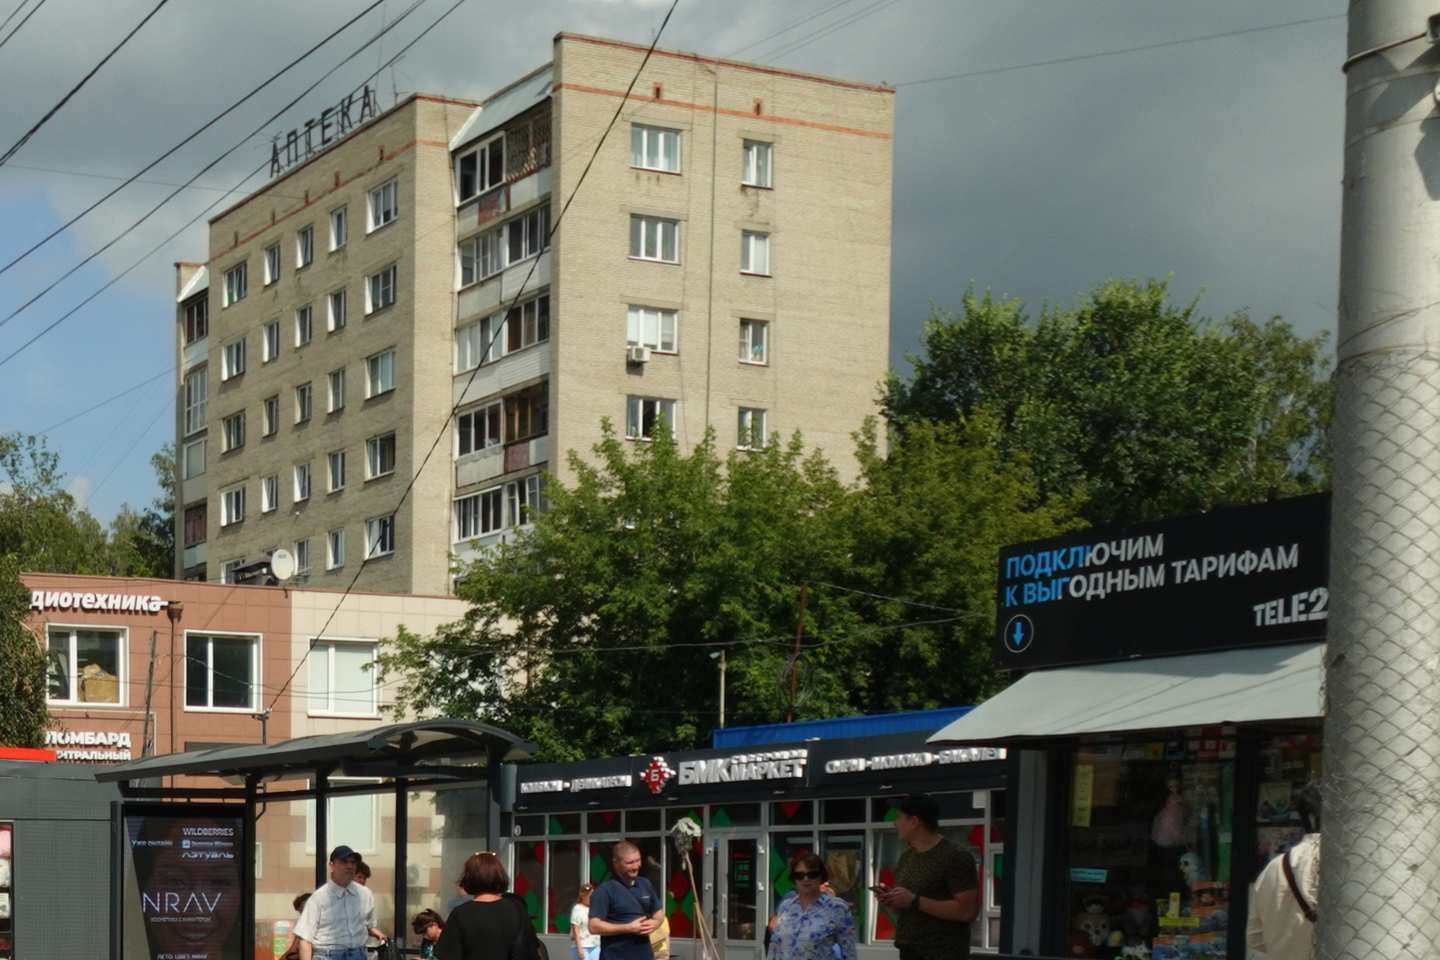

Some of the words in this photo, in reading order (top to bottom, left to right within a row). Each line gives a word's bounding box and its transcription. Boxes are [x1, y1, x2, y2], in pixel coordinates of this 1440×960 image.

[269, 85, 374, 178] АПТЕКА
[1005, 533, 1164, 579] ПОДКЛЮЧИМ
[1005, 585, 1018, 607] К
[1023, 563, 1165, 606] ВЫГОДНЫМ
[1171, 543, 1299, 584] ТАРИФАМ
[29, 590, 162, 613] диотехника
[1252, 587, 1329, 626] TELE2
[45, 730, 131, 748] ЛОМБАРД
[57, 749, 131, 760] НТРАЛЬНЫЙ
[678, 758, 731, 785] БМК
[730, 759, 807, 781] МАРКЕТ
[142, 892, 222, 913] NRAV
